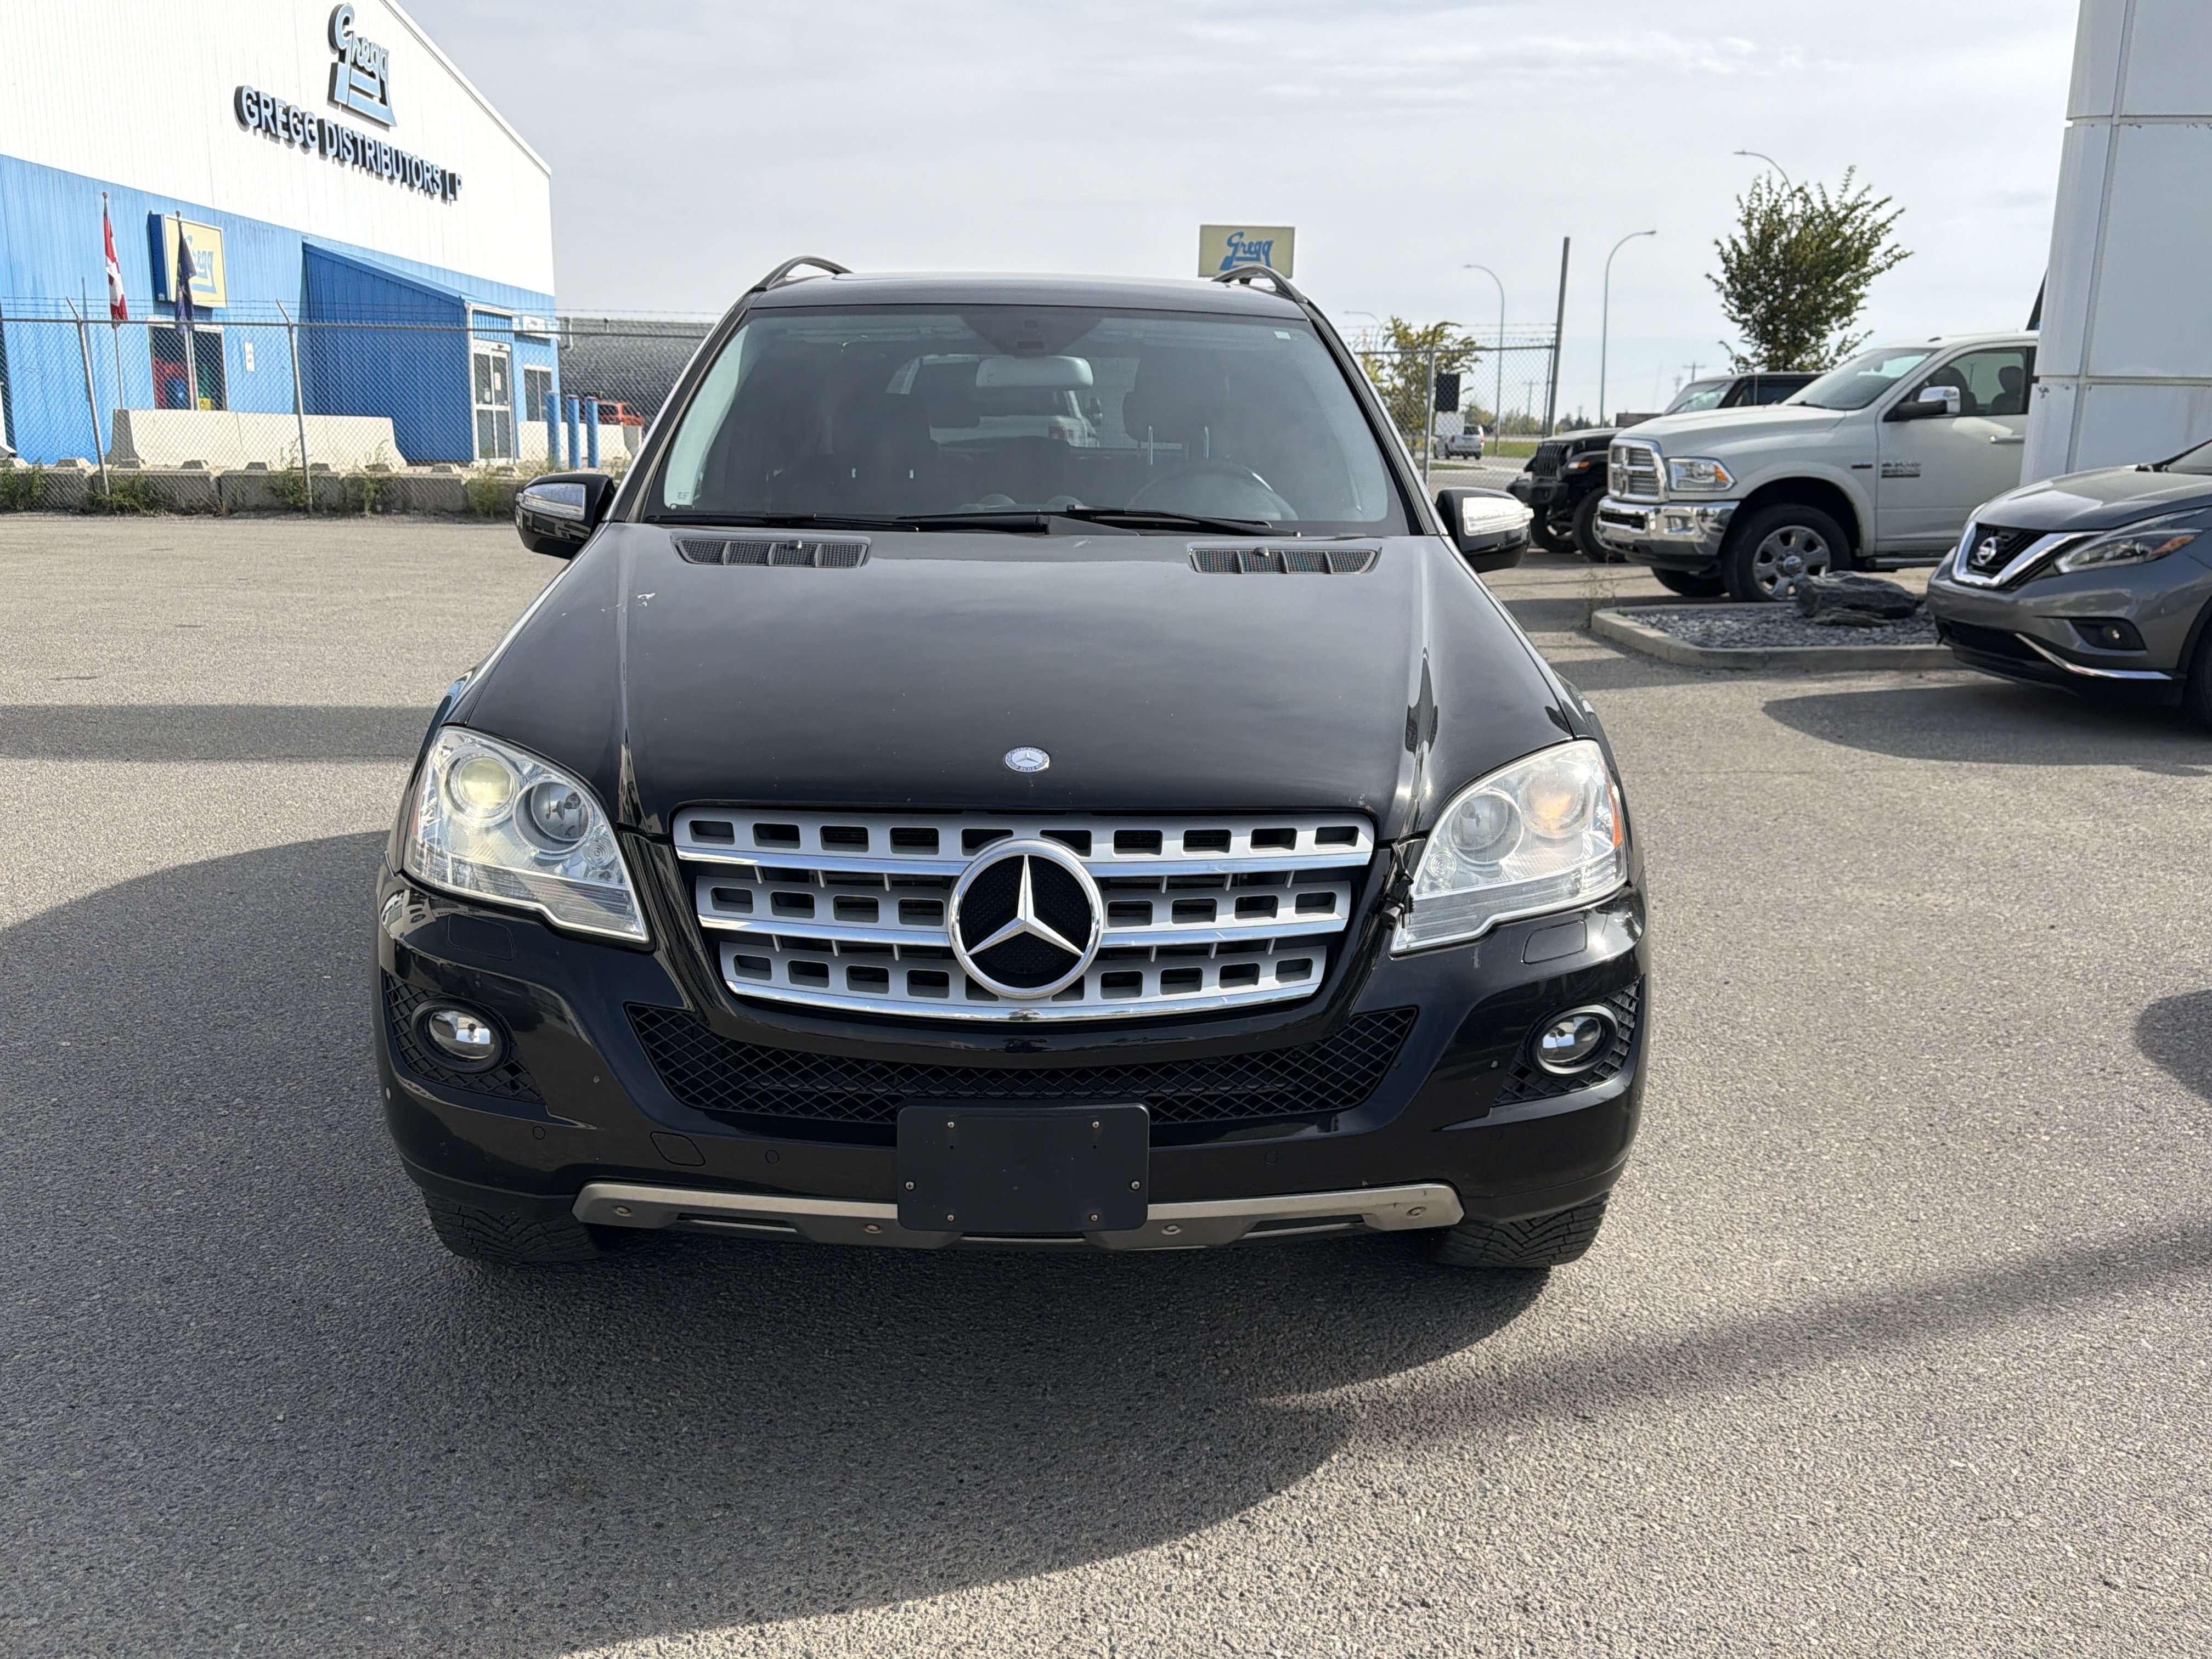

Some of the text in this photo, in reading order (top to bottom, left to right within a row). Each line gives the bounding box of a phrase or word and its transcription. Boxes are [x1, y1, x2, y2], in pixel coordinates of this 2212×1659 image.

[332, 3, 396, 127] Gregg
[235, 85, 462, 201] GREGG DISTRIBUTORS LP
[1220, 231, 1274, 270] Gregg
